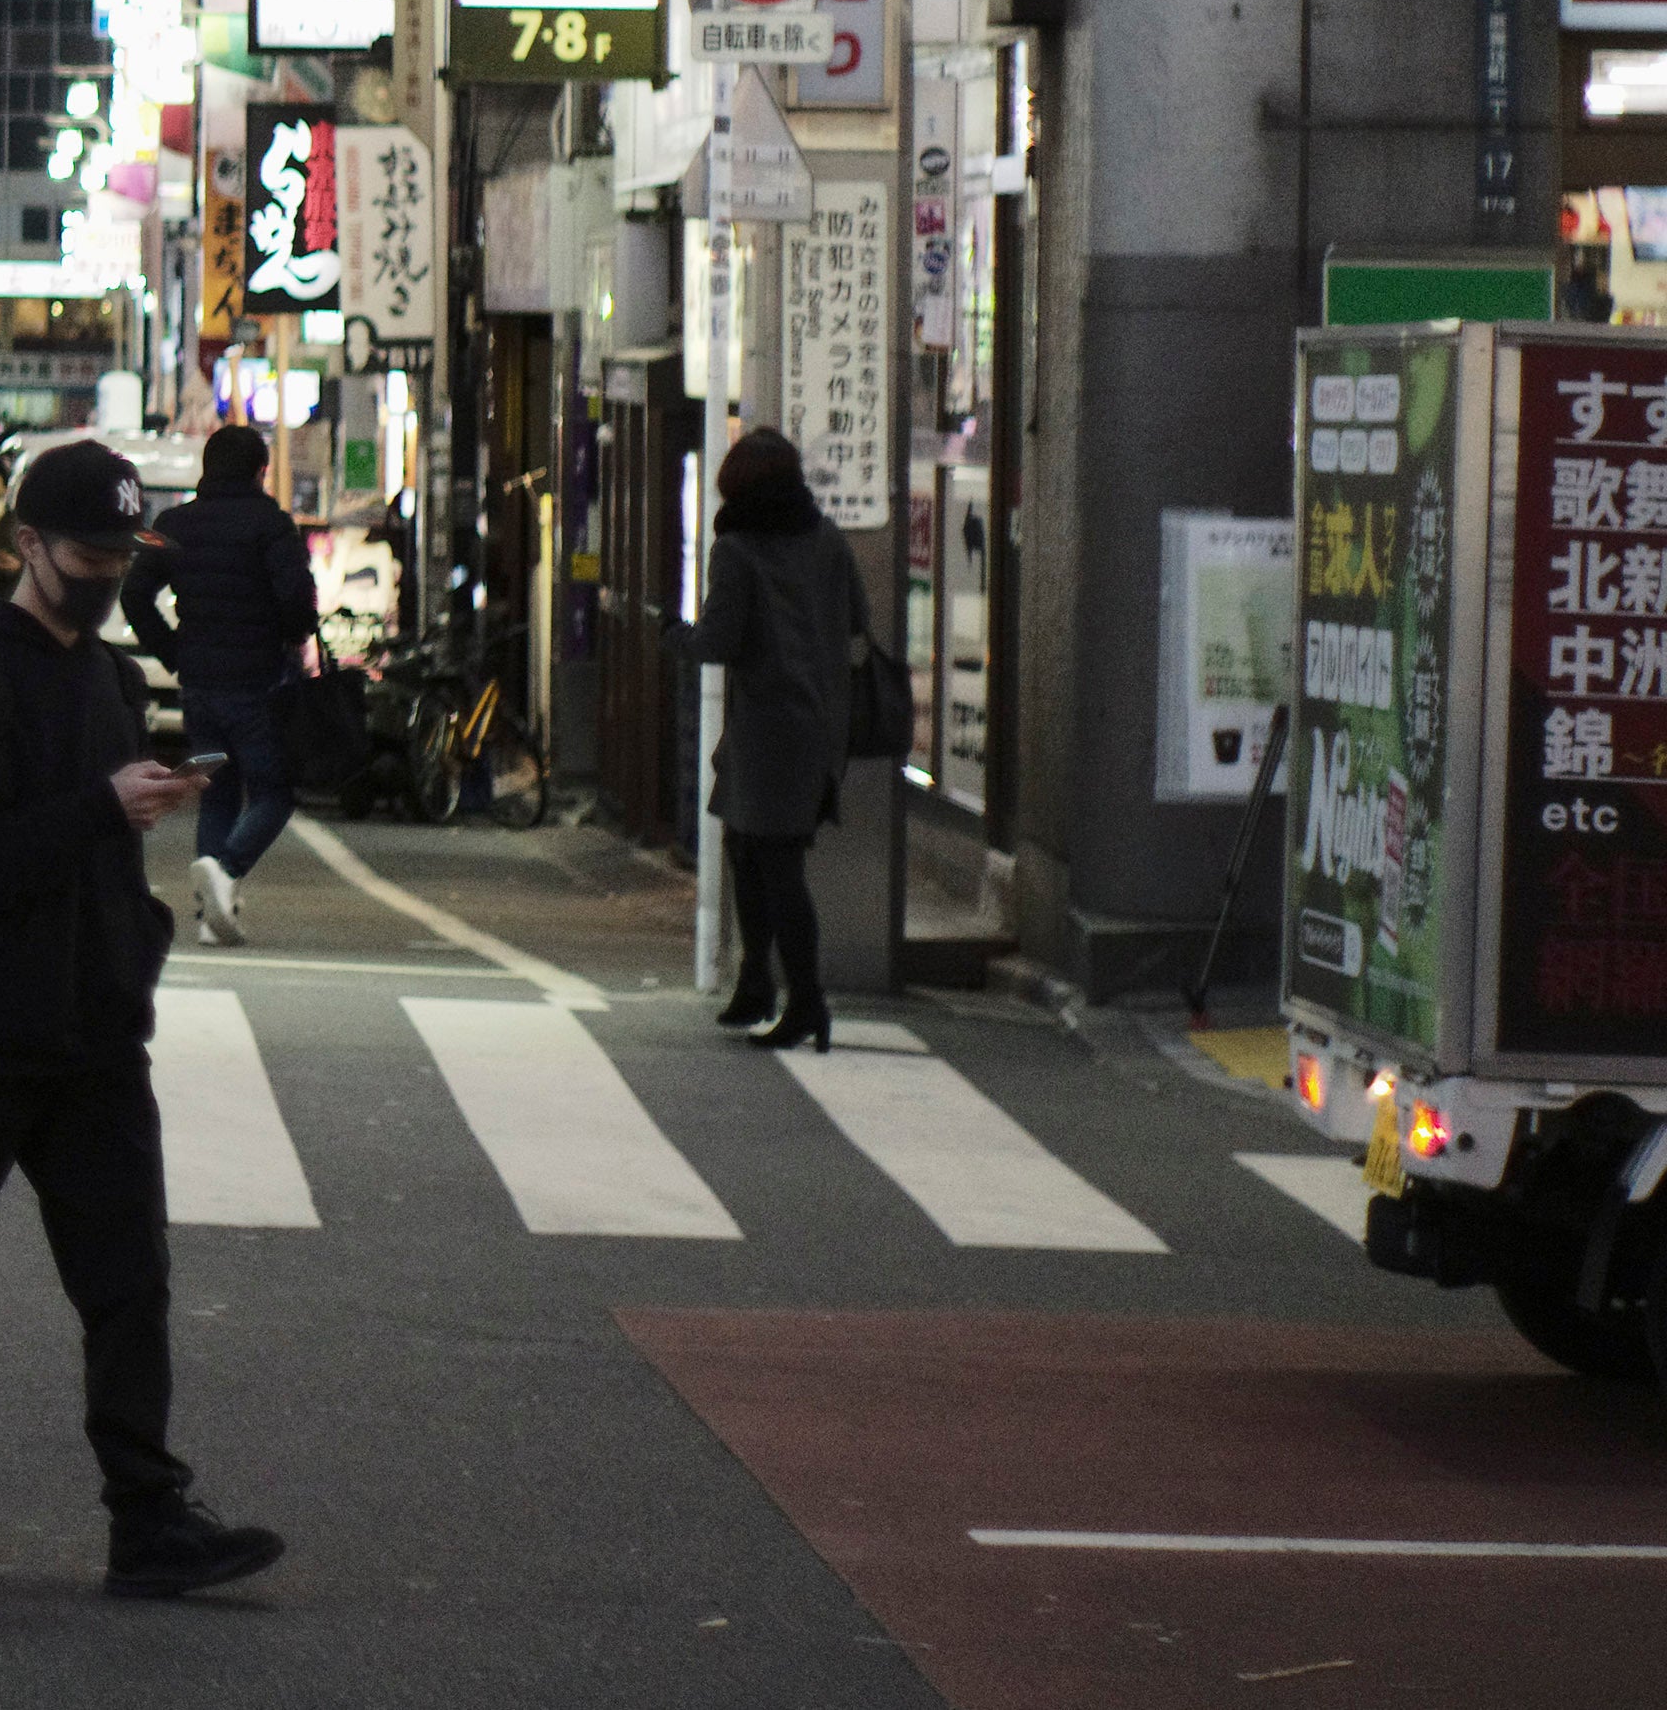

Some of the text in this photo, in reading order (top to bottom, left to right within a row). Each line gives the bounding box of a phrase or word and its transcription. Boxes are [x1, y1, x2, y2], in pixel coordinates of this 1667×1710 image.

[702, 23, 822, 53] 自転車を除く
[827, 209, 855, 468] 防犯カメラ作動中
[116, 478, 141, 516] NY
[1543, 708, 1613, 780] 錦
[1541, 797, 1620, 835] etc
